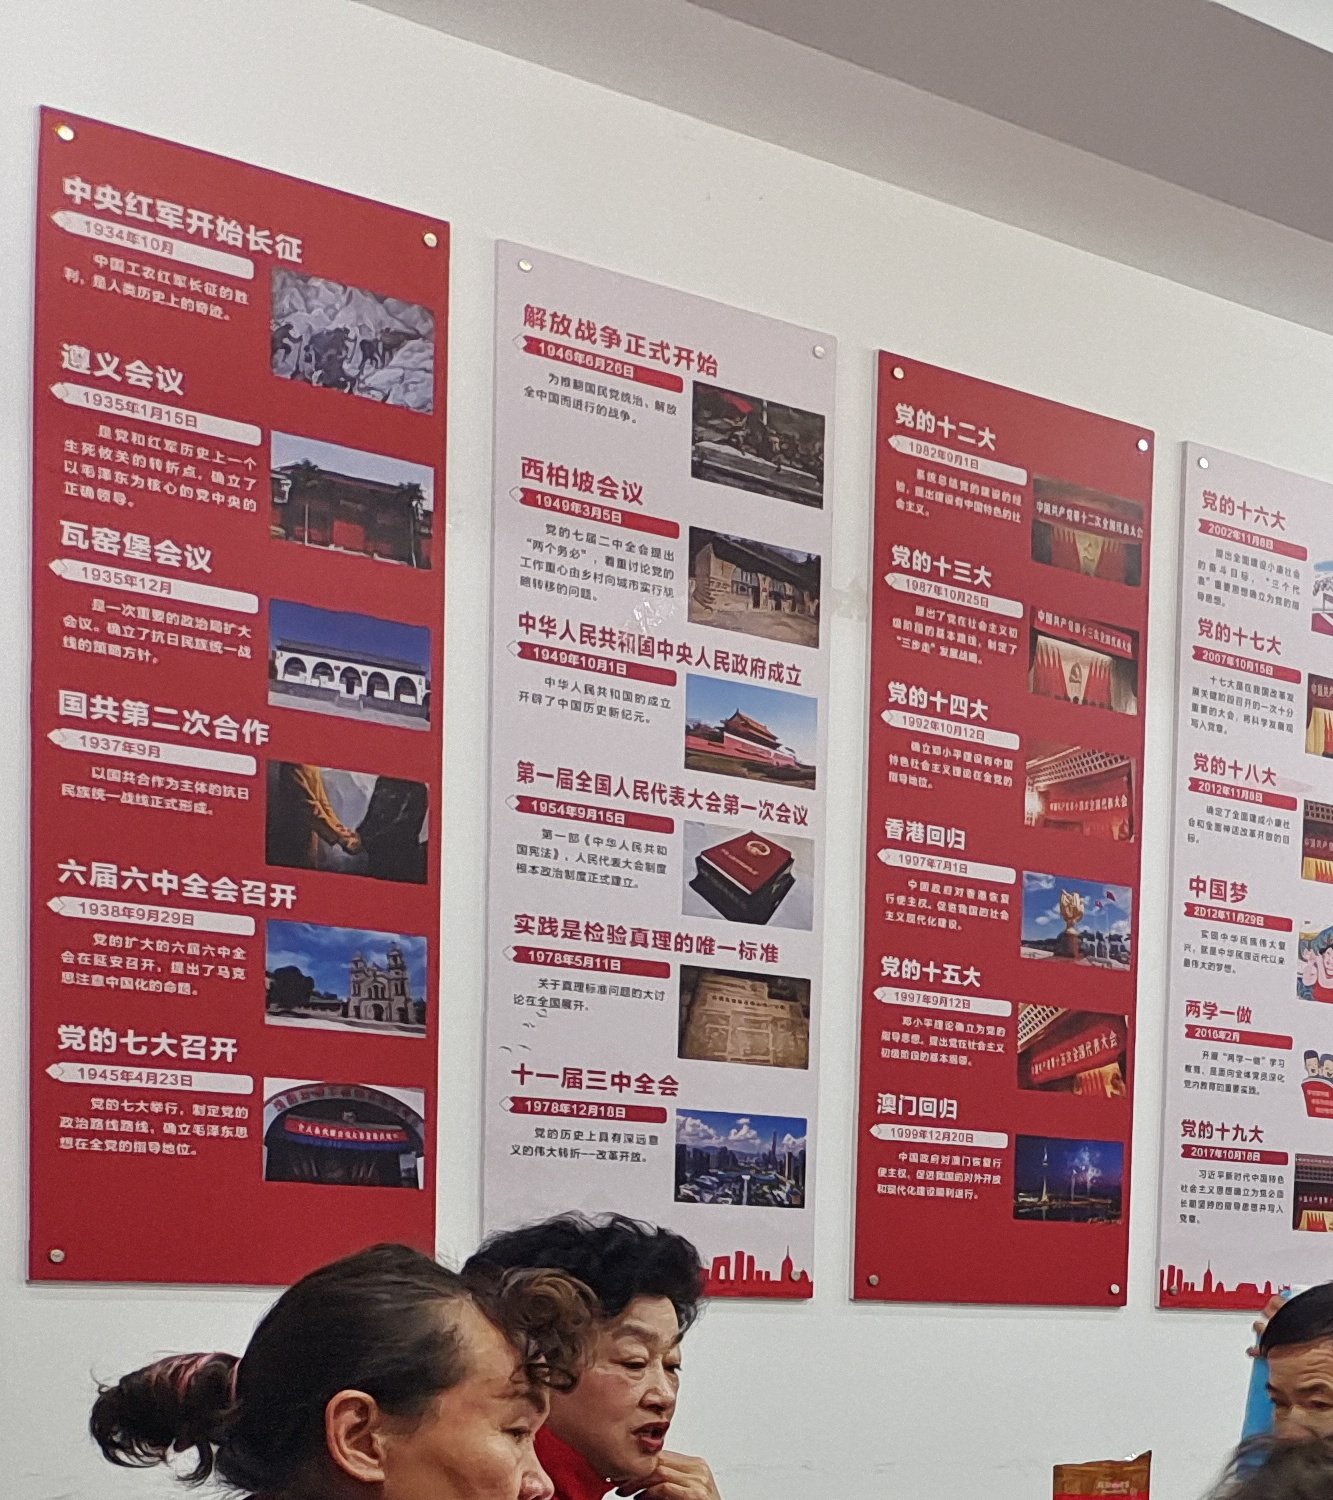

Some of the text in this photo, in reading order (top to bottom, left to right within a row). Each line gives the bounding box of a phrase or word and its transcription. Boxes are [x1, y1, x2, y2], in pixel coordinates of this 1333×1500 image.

[63, 172, 302, 264] 中央红军开始长征
[84, 219, 173, 255] 1934年10月
[93, 252, 249, 305] 中国工农红军长征的胜
[522, 302, 718, 378] 解放战争正式开始
[61, 341, 183, 396] 遵义会议
[537, 341, 634, 378] 1946年6月26日
[83, 390, 197, 429] 1935年1月15日
[894, 400, 997, 452] 党的十二大
[98, 424, 257, 472] 是党和红军历史上一个
[63, 459, 256, 513] 以毛泽东为核心的党中央的
[64, 480, 134, 508] 正确领导。
[520, 455, 644, 507] 西柏坡会议
[535, 493, 622, 525] 1949年3月5日
[1201, 488, 1286, 532] 党的十六大
[59, 518, 212, 574] 瓦窑堡会议
[545, 522, 674, 562] 党的七届二中全会提出
[81, 565, 172, 595] 1935年12月
[891, 543, 992, 589] 党的十三大
[905, 578, 989, 609] 1987年10月25日
[91, 597, 252, 639] 是一次重要的政治局扩大
[62, 634, 160, 664] 线的策略方针。
[517, 609, 802, 687] 中华人民共和国中央人民政府成立
[1197, 616, 1282, 656] 党的十七大
[532, 646, 627, 676] 1949年10月1日
[1202, 649, 1274, 676] 2007年10月15日
[518, 690, 650, 725] 开辟了中国历史新纪元。
[544, 676, 671, 710] 中华人民共和国的成立
[887, 680, 989, 722] 党的十四大
[58, 688, 269, 747] 国共第二次合作
[901, 714, 985, 741] 1992年10月12日
[79, 733, 161, 759] 1937年9月
[91, 765, 249, 801] 以国共合作为主体的抗日
[1193, 751, 1277, 787] 党的十八大
[515, 759, 809, 827] 第一届全国人民代表大会第一次会议
[530, 799, 625, 825] 1954年9月15日
[884, 816, 966, 851] 香港回归
[898, 853, 968, 874] 1997年7月1日
[57, 856, 296, 910] 六届六中全会召开
[1188, 873, 1248, 906] 中国梦
[79, 900, 194, 926] 1938年9月29日
[1193, 906, 1265, 927] 2012年11月29日
[92, 932, 246, 961] 党的扩大的六届六中全
[512, 913, 779, 964] 实践是检验真理的唯一标准
[527, 948, 621, 971] 1978年5月11日
[880, 954, 981, 988] 党的十五大
[538, 978, 665, 1002] 关于真理标准问题的大讨
[894, 990, 971, 1009] 1997年9月12日
[1184, 998, 1252, 1025] 两学一做
[57, 1022, 238, 1063] 党的七大召开
[77, 1065, 193, 1087] 1945年4月23日
[510, 1062, 680, 1098] 十一届三中全会
[525, 1100, 626, 1119] 1978年12月18日
[876, 1092, 958, 1120] 澳门回归
[59, 1136, 198, 1157] 想在全党的指导地位。
[533, 1126, 659, 1146] 党的历史上具有深远意
[890, 1127, 973, 1143] 1999年12月20日
[1180, 1118, 1264, 1144] 党的十九大
[1190, 1146, 1261, 1162] 2017年10月18日
